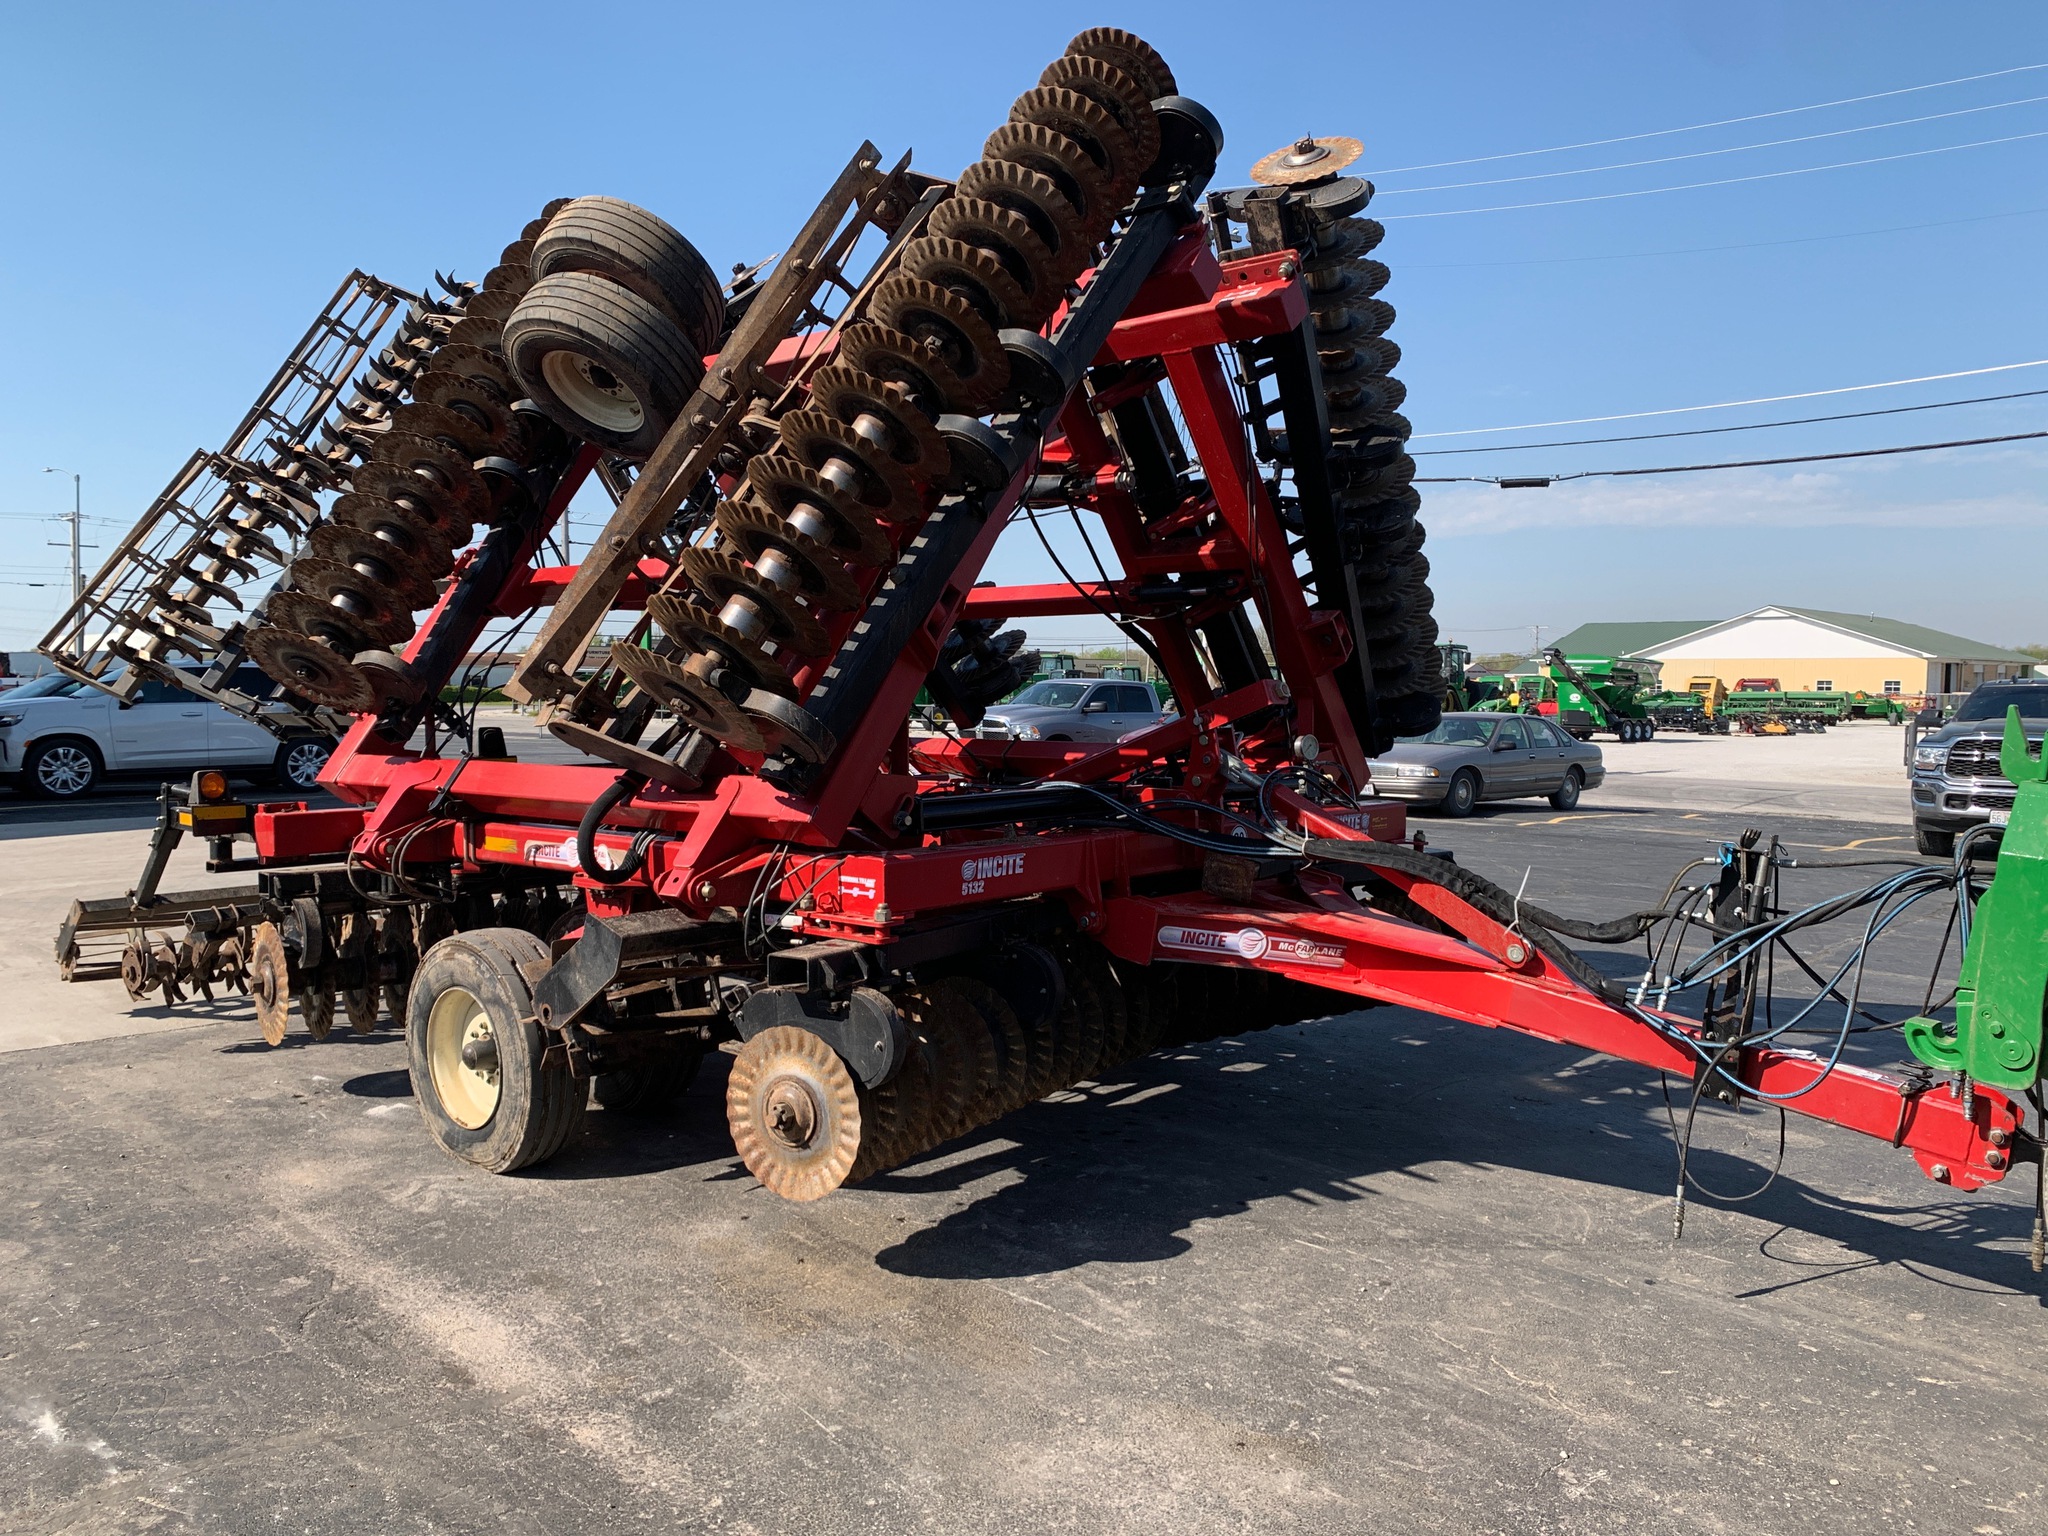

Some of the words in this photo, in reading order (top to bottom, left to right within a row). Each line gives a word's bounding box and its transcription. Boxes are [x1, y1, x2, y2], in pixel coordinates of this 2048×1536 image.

[977, 853, 1025, 879] INCITE
[962, 881, 984, 895] 5132
[1180, 931, 1227, 947] INCITE
